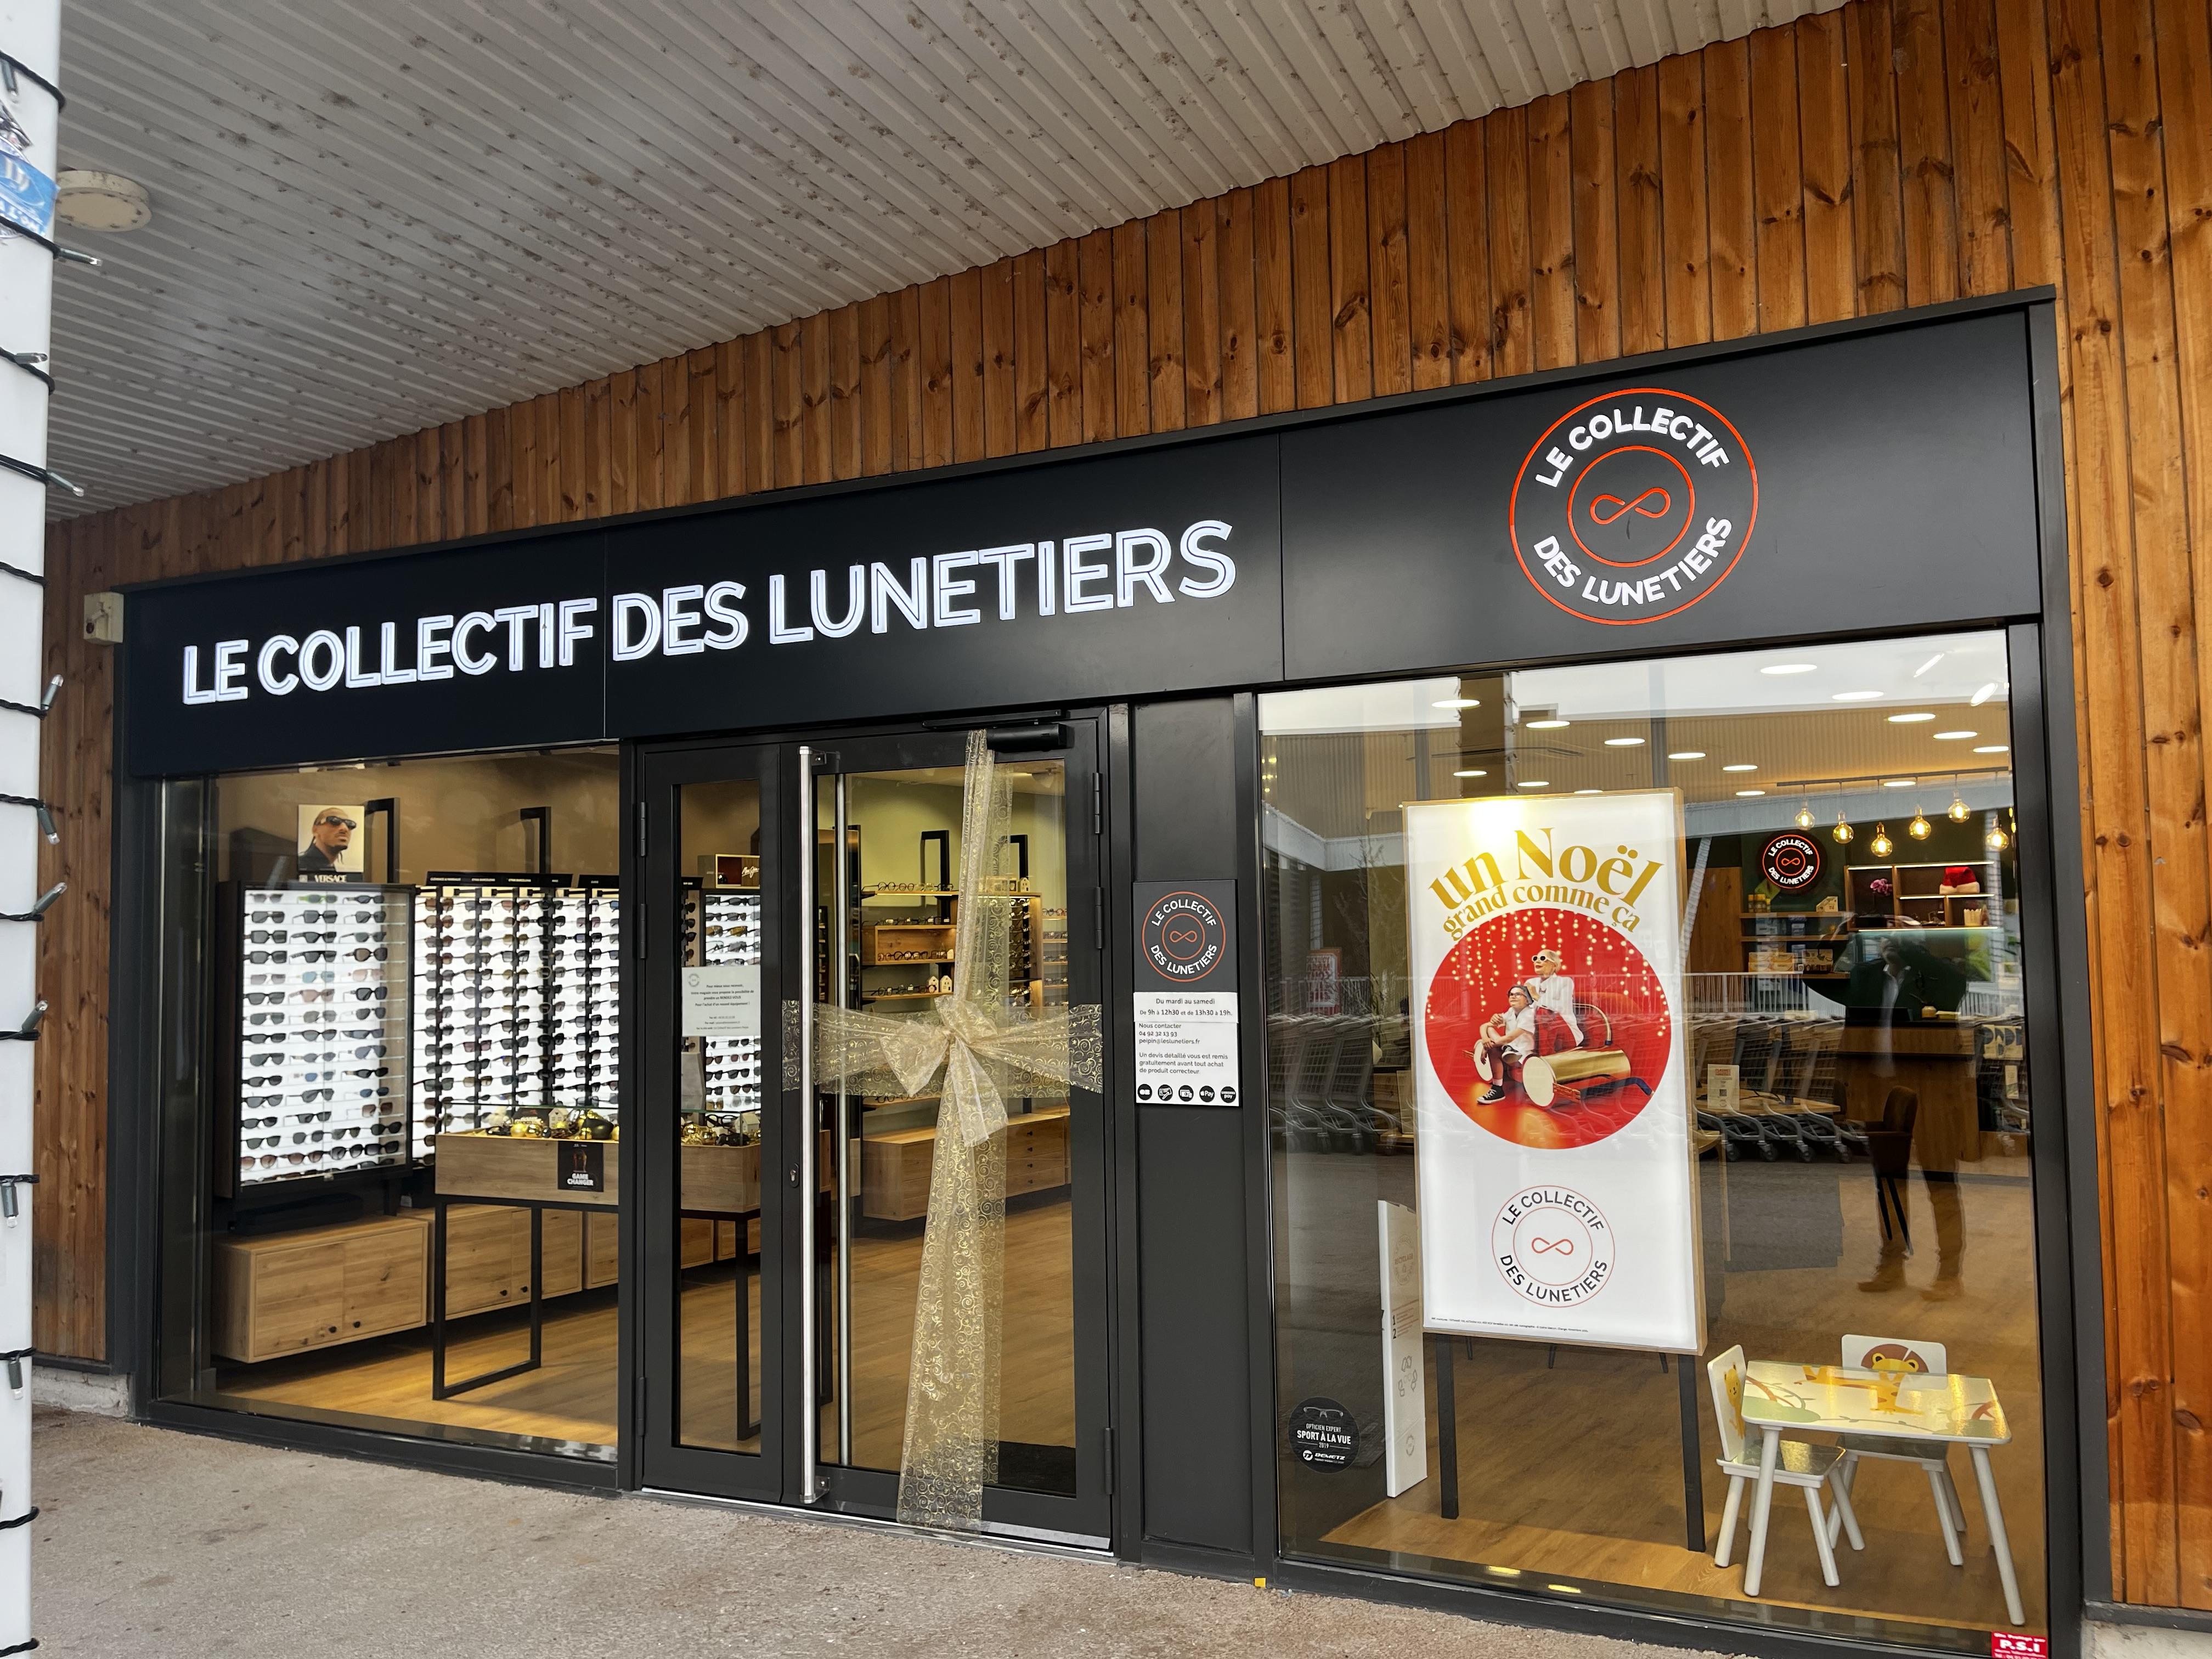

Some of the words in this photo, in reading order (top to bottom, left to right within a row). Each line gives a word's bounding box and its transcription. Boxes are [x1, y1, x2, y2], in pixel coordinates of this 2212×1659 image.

[1536, 447, 1573, 487] LE
[1568, 407, 1729, 468] COLLECTIF
[1534, 535, 1581, 587] DES
[1582, 517, 1732, 605] LUNETIERS
[182, 640, 249, 705] LE
[257, 597, 597, 696] COLLECTIF
[613, 581, 748, 662] DES
[769, 520, 1236, 645] LUNETIERS
[1768, 847, 1778, 857] LE
[1776, 839, 1813, 855] COLLECTIF
[314, 874, 347, 883] VERSACE
[1428, 851, 1509, 910] un
[1514, 827, 1664, 909] Noël
[1768, 867, 1780, 880] DES
[1780, 865, 1814, 884] LUNETIERS
[1152, 911, 1165, 926] LE
[1163, 899, 1216, 926] COLLECTIF
[1443, 885, 1508, 942] grand
[1513, 884, 1610, 914] comme
[1611, 903, 1640, 933] ça
[1150, 945, 1167, 966] DES
[1166, 944, 1217, 974] LUNETIERS
[1502, 1204, 1521, 1225] LE
[1521, 1190, 1605, 1232] COLLECTIF
[1500, 1255, 1525, 1286] DES
[1526, 1260, 1608, 1302] LUNETIERS
[1297, 1430, 1319, 1441] SPORT
[1320, 1431, 1326, 1442] À
[1327, 1434, 1336, 1443] LA
[1337, 1435, 1351, 1444] VUE
[1306, 1423, 1325, 1431] OPTICIEN
